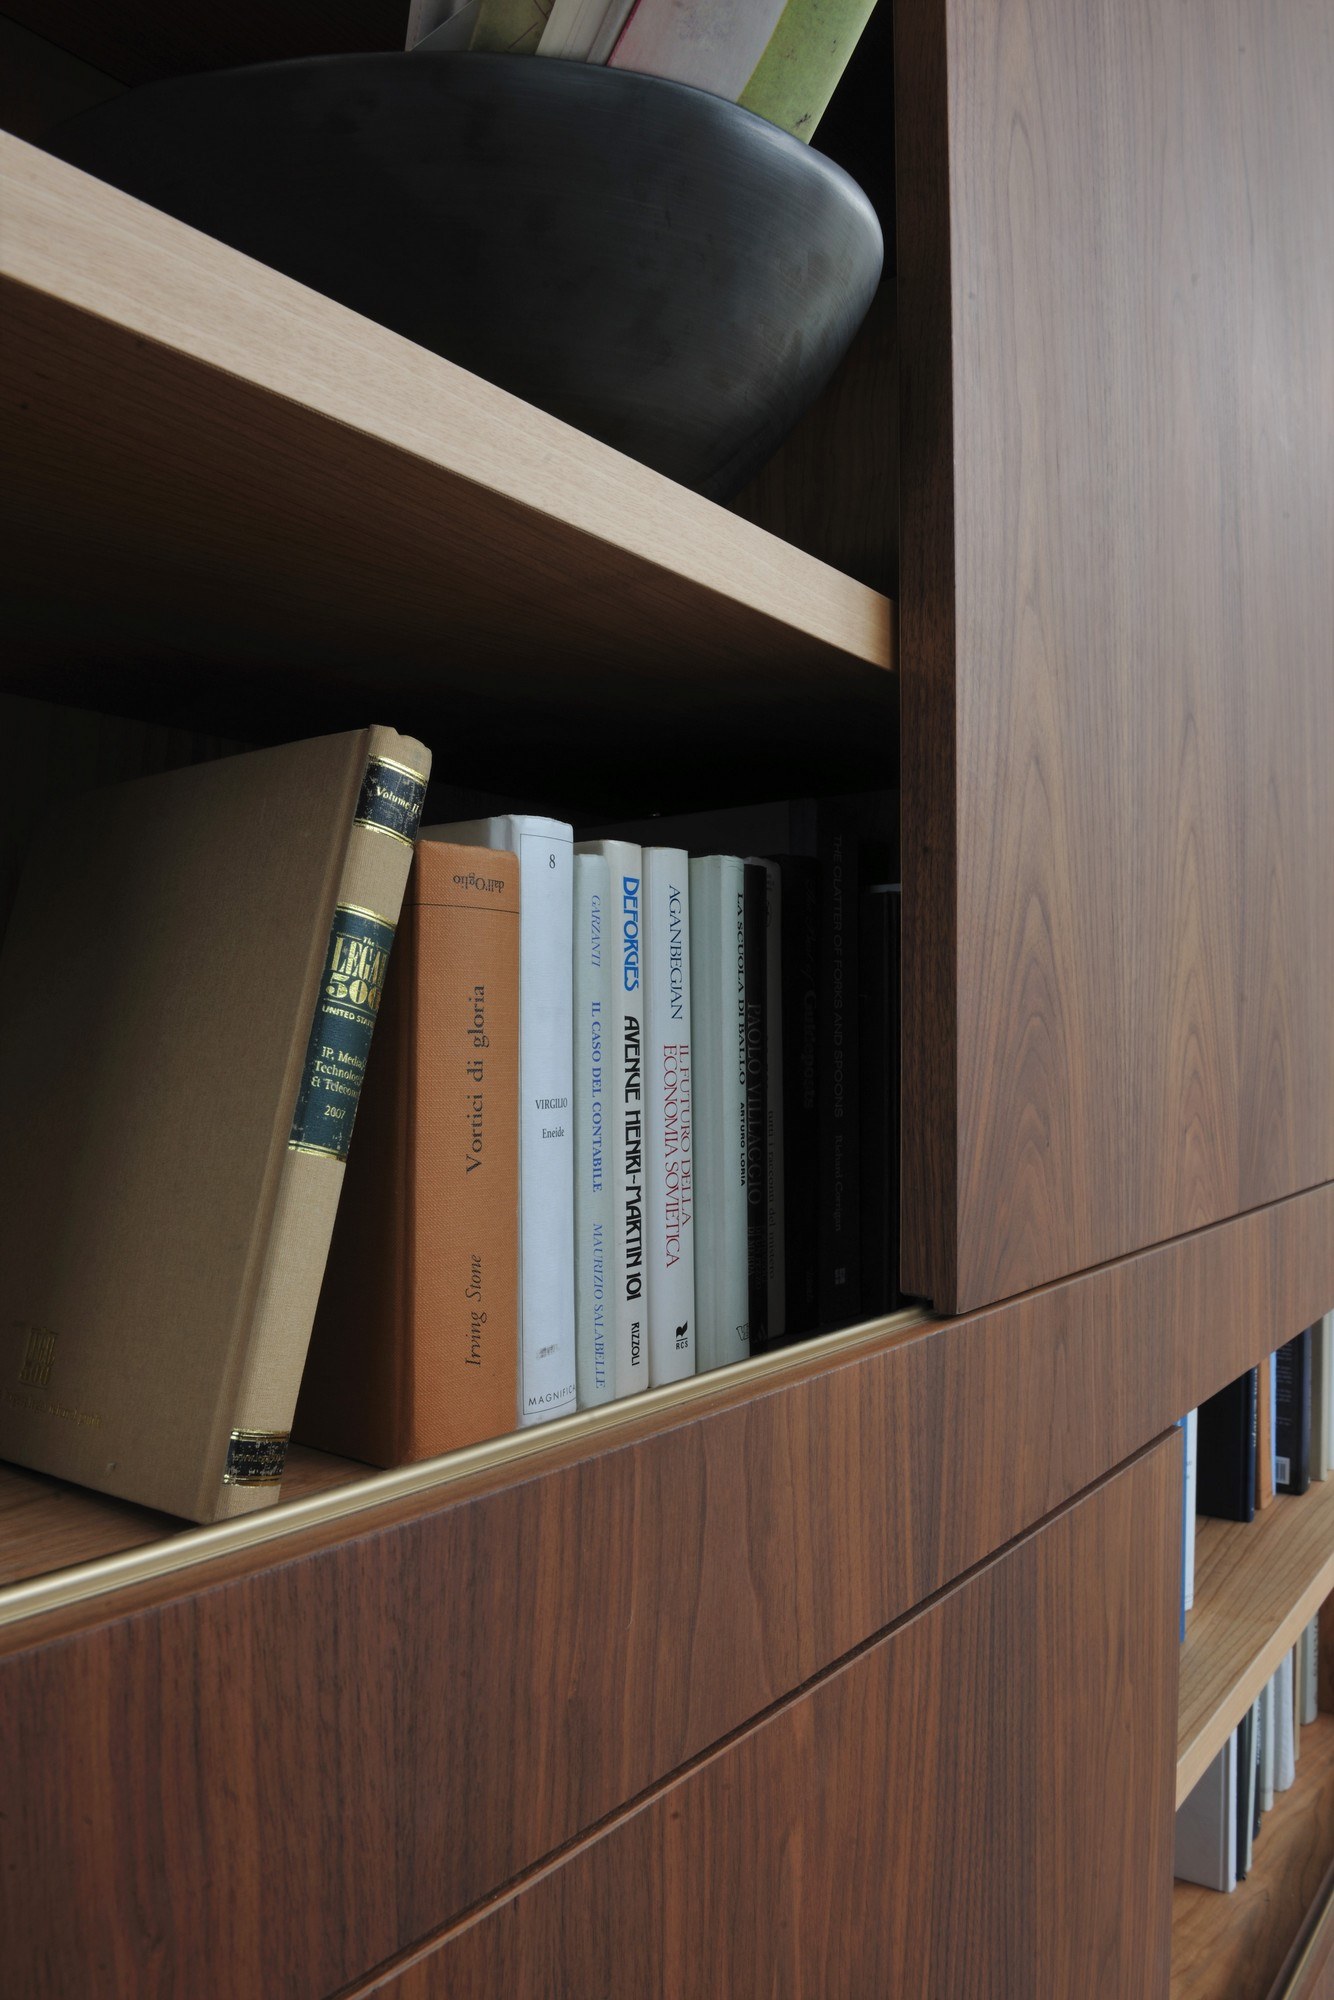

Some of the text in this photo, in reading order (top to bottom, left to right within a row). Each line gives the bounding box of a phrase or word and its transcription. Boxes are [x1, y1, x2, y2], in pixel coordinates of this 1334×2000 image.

[376, 786, 419, 813] Volume II
[453, 872, 505, 893] dall'Oglio
[549, 853, 556, 869] 8
[737, 893, 744, 916] LA
[363, 936, 375, 947] The
[623, 876, 640, 992] DEFORGES
[669, 885, 683, 1020] AGANBEGJAN
[331, 937, 387, 987] LEGAL
[833, 834, 844, 1118] THE CLATTER OF FORKS AND SPOONS
[326, 972, 382, 1010] 500
[737, 999, 745, 1017] DI
[322, 1004, 375, 1029] UNITED STATE
[624, 1015, 641, 1103] AVENUE
[737, 1023, 745, 1085] BALLO
[801, 990, 817, 1109] Guideposts
[311, 1076, 321, 1087] &
[466, 986, 489, 1173] Vortici di gloria
[747, 1002, 762, 1205] PAOLO VILLAGGIO
[324, 1105, 346, 1119] 2007
[680, 1045, 692, 1227] IL FUTURO DELLA
[591, 895, 606, 1389] GARZANTI IL CASO DEL CONTABILE MAURIZIO SALABELLE
[664, 1045, 680, 1268] ECONOMIA SOVIETICA
[768, 1149, 776, 1203] racconti
[833, 1135, 844, 1232] Richard Corrigan
[768, 1208, 777, 1227] del
[768, 1232, 777, 1280] mistero
[464, 1255, 487, 1367] Irving Stone
[626, 1272, 642, 1301] 101
[631, 1322, 641, 1366] RIZZOLI
[675, 1341, 688, 1350] RCS
